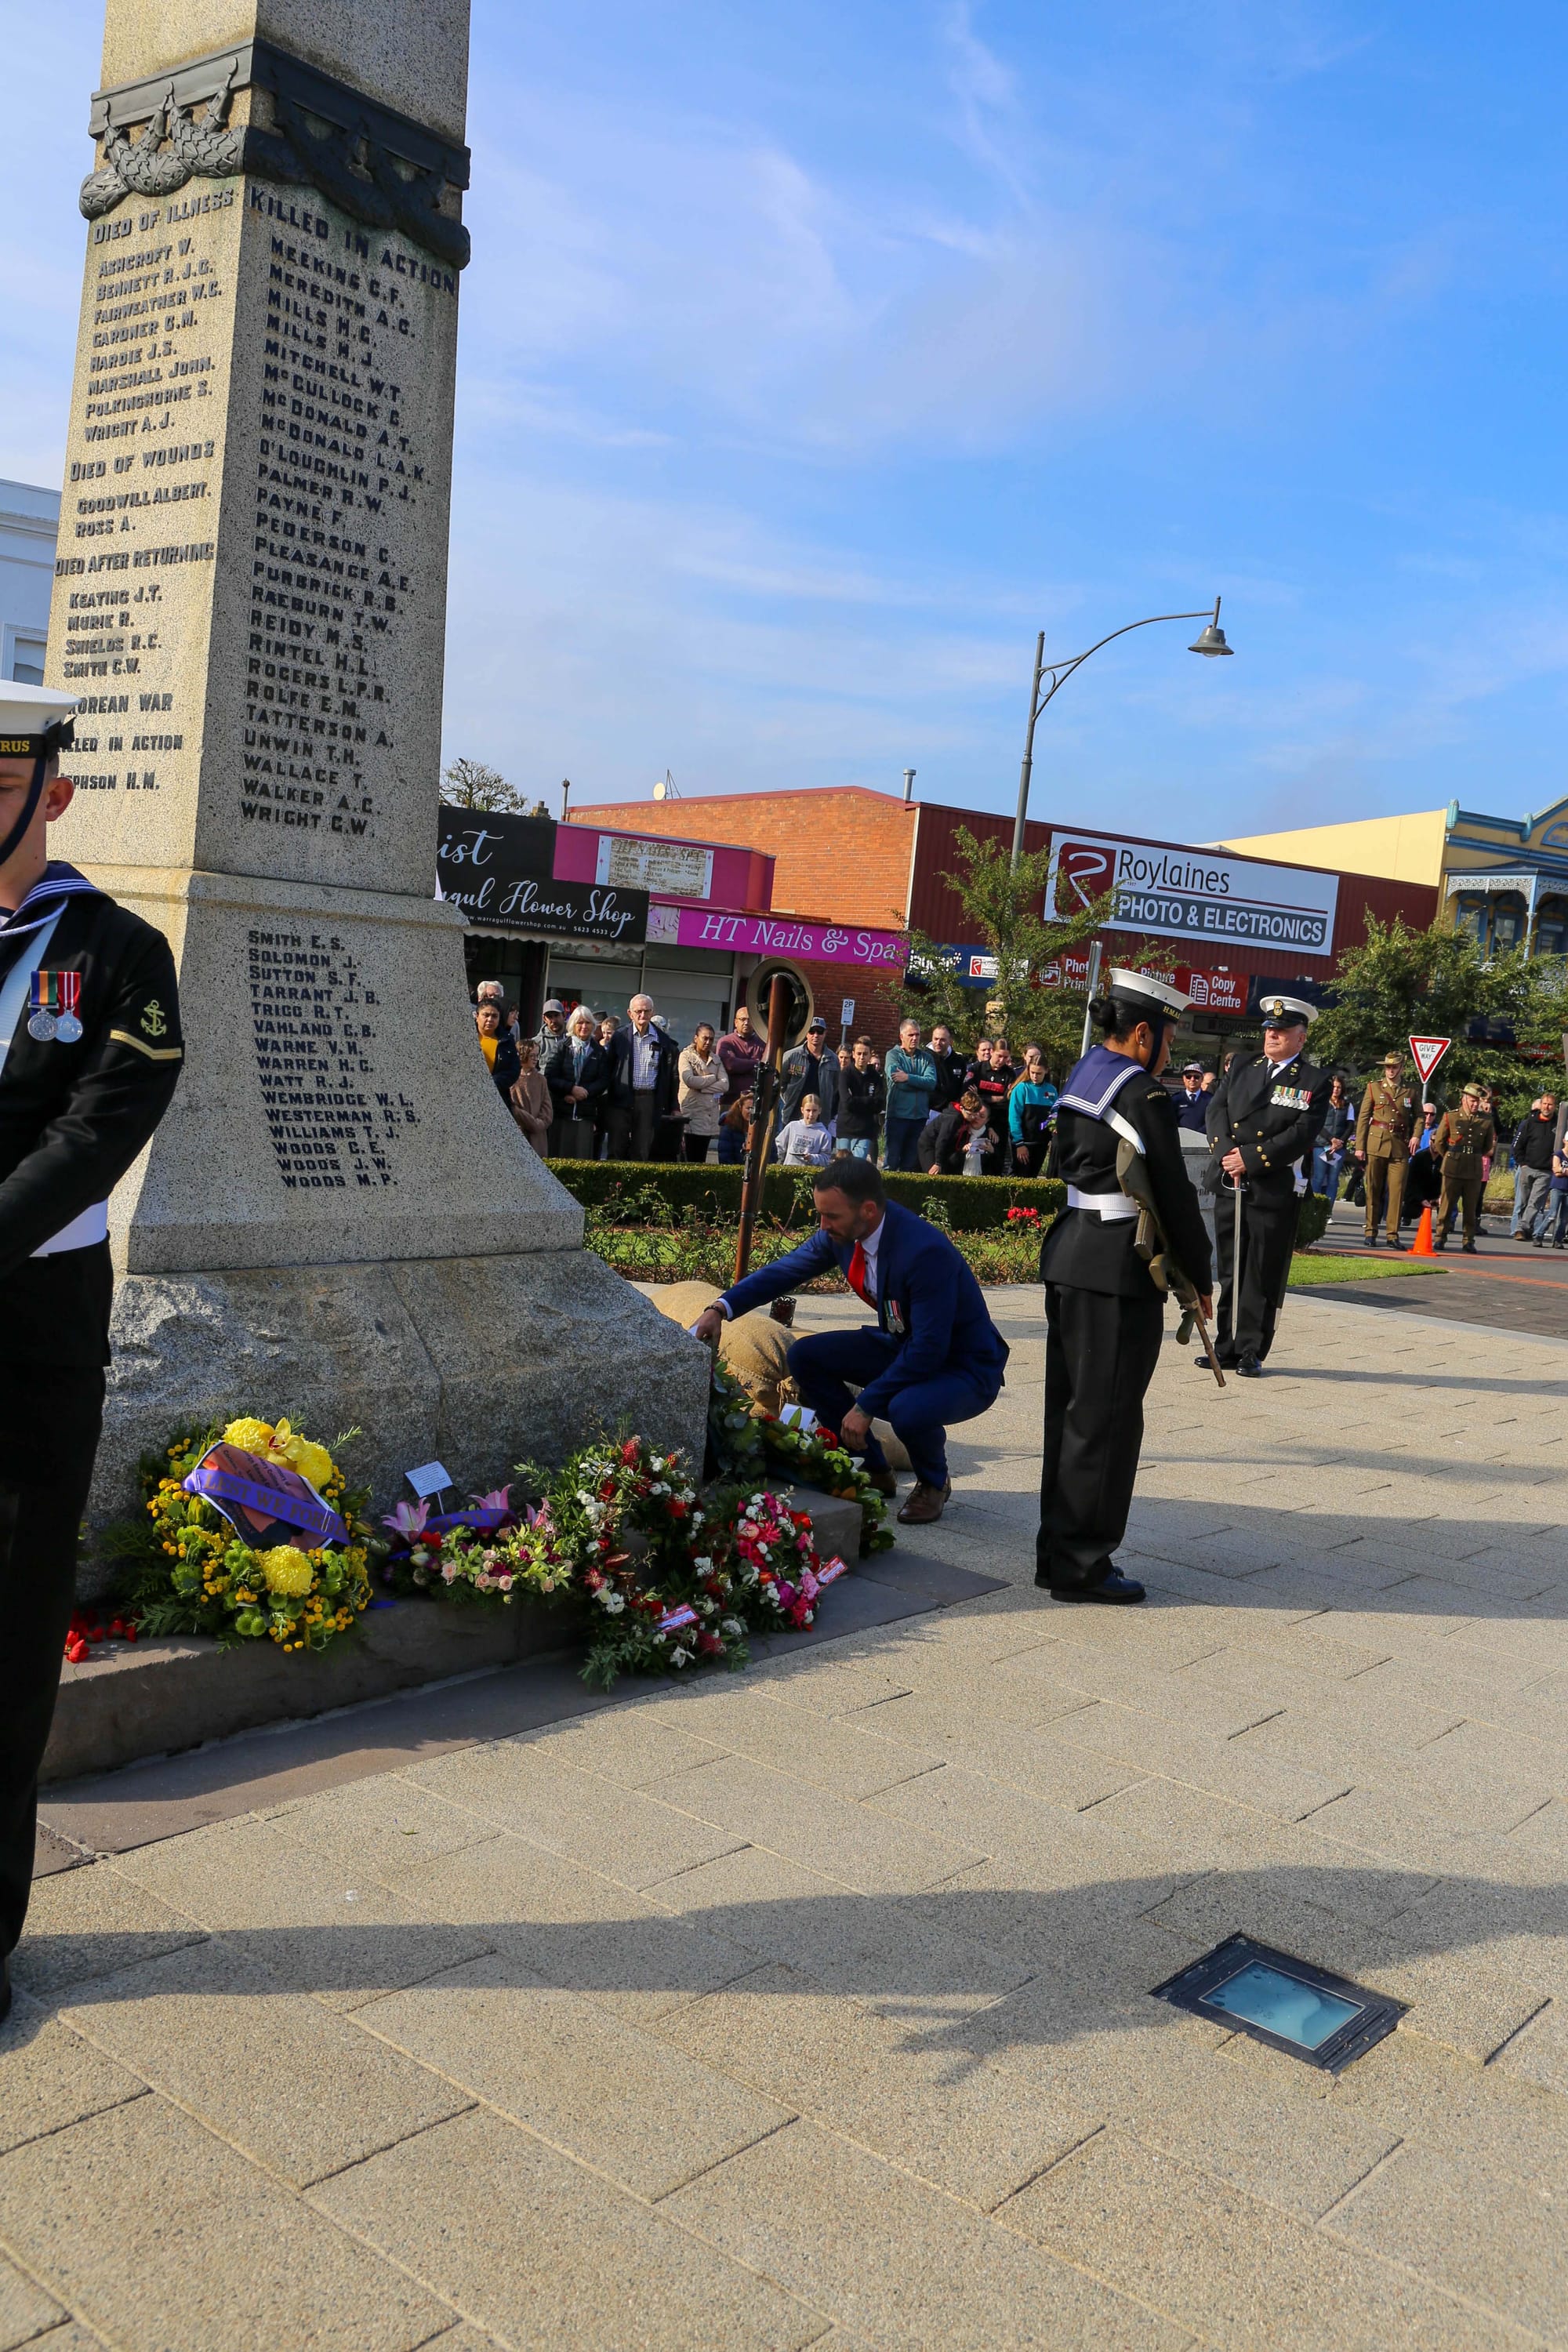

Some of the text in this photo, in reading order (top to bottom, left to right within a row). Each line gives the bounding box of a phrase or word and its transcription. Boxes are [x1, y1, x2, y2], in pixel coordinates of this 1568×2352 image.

[93, 188, 234, 245] DIED OF ILLNESS
[250, 187, 456, 296] KILLED IN ACTION
[99, 238, 194, 278] ASHCROFT W.
[271, 236, 361, 290] MEEKING
[96, 272, 158, 300] BENNETT
[269, 264, 365, 318] MEREDITH
[94, 289, 187, 324] FAIRWEATHER
[268, 289, 327, 328] MILLS
[92, 320, 158, 348] GARDNER
[267, 314, 327, 350] MILLS
[89, 347, 142, 372] HARDIE
[264, 339, 361, 387] MITCHELL
[88, 357, 215, 394] MARSHALL JOHN.
[85, 380, 212, 418] POLKINGHORNE S.
[85, 419, 136, 442] WRIGHT
[70, 440, 214, 481] DIED OF WOUNDS
[258, 463, 332, 499] PALMER
[78, 491, 151, 514] GOODWILL
[256, 487, 321, 521] PAYNE
[75, 518, 114, 537] ROSS
[256, 511, 365, 557] PEDERSON
[55, 543, 214, 575] DIED AFTER RETURNING
[254, 535, 370, 582] PLEASANCE
[252, 561, 354, 601] PURBRICK
[70, 590, 129, 608] KEATING
[252, 586, 343, 622] RAEBURN
[250, 608, 315, 639] REIDY
[66, 637, 124, 655] SHIELDS
[249, 633, 325, 666] RINTEL
[63, 661, 107, 678] SMITH
[248, 657, 330, 689] ROGERS
[140, 693, 172, 712] WAR
[247, 680, 310, 709] ROLFE
[246, 704, 366, 742] TATTERSON
[0, 740, 30, 753] RUS
[109, 736, 122, 751] IN
[132, 735, 183, 750] ACTION
[244, 728, 313, 758] UNWIN
[244, 753, 339, 785] WALLACE
[243, 779, 324, 806] WALKER
[241, 801, 321, 829] WRIGHT
[1118, 850, 1230, 893] Roylaines
[499, 880, 577, 919] Flower
[583, 889, 635, 938] Shop
[1119, 895, 1322, 942] PHOTO & ELECTRONICS
[249, 931, 301, 947] SMITH
[699, 915, 747, 942] HT
[751, 920, 813, 951] Nails
[822, 928, 848, 953] &
[853, 932, 896, 963] Spa
[249, 949, 331, 967] SOLOMON
[249, 966, 315, 983] SUTTON
[1211, 975, 1236, 993] Copy
[250, 984, 332, 1002] TARRANT
[1210, 993, 1241, 1008] Centre
[254, 1020, 332, 1036] VAHLAND
[254, 1038, 316, 1053] WARNE
[256, 1057, 329, 1072] WARREN
[259, 1074, 303, 1087] WATT
[261, 1091, 367, 1105] WEMBRIDGE
[265, 1109, 372, 1123] WESTERMAN
[269, 1126, 359, 1138] WILLIAMS
[272, 1142, 336, 1155] WOODS
[277, 1159, 340, 1171] WOODS
[281, 1175, 346, 1188] WOODS
[205, 1474, 251, 1500] LEST
[256, 1490, 287, 1515] WE
